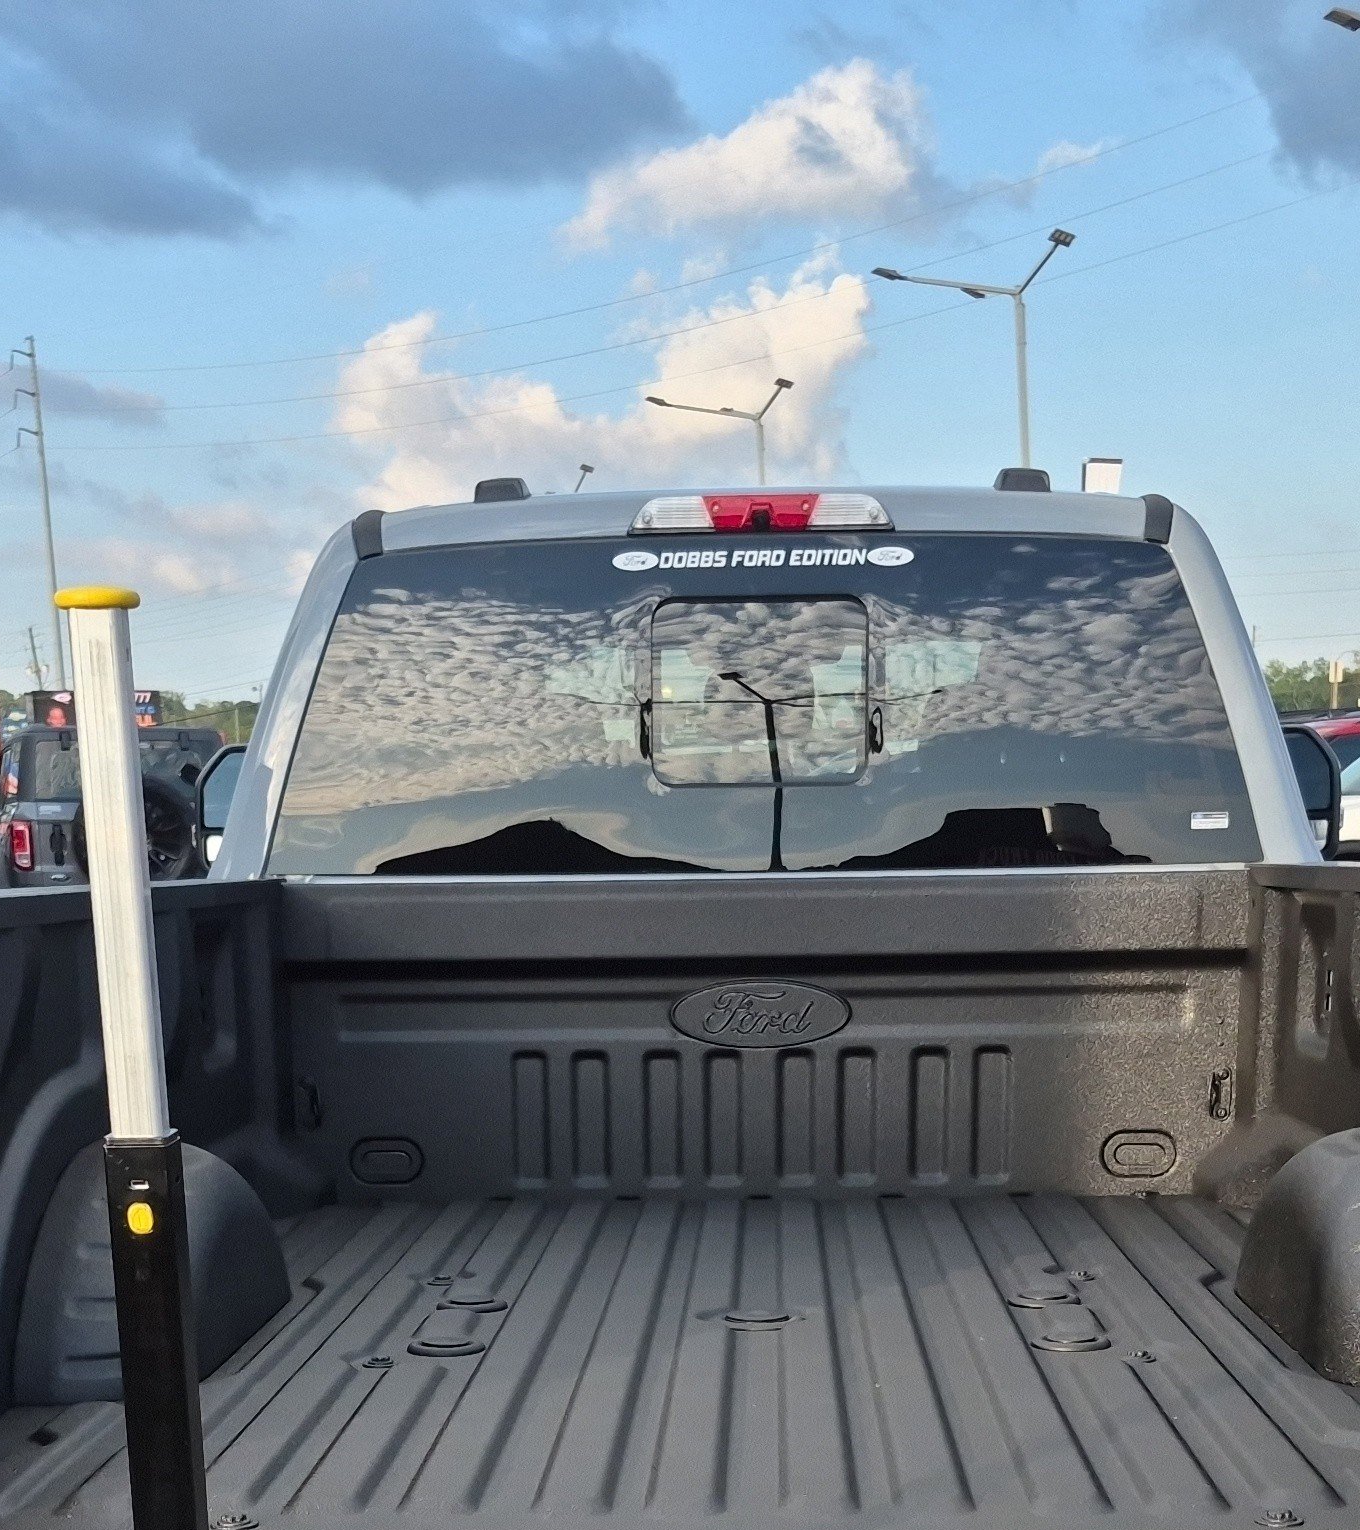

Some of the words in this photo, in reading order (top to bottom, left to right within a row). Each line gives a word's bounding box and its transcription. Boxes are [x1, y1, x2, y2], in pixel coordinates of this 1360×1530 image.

[658, 551, 729, 569] DOBBS
[731, 550, 786, 568] FORD
[789, 548, 867, 567] EDITION
[703, 990, 814, 1035] Ford
